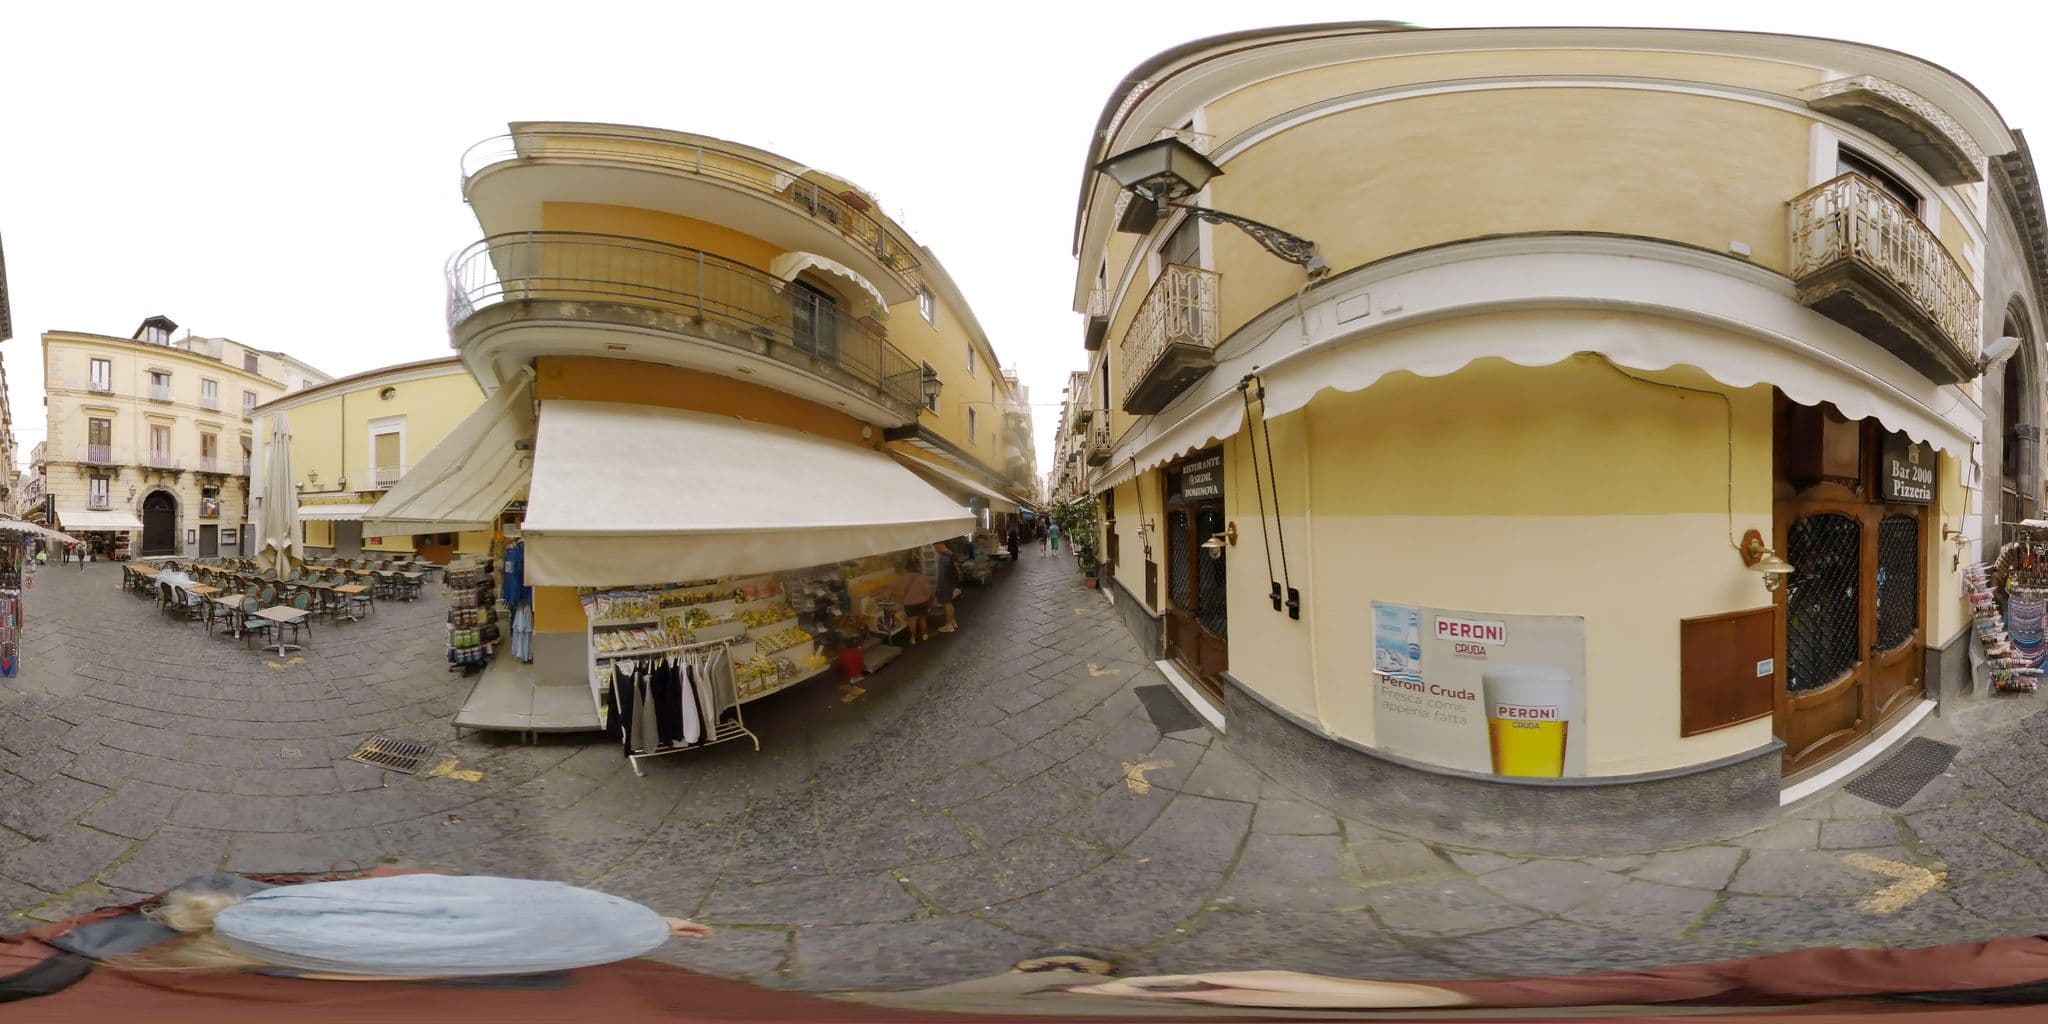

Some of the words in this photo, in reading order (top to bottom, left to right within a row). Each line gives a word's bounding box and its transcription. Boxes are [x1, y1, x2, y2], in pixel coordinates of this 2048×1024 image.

[1183, 456, 1221, 474] RISTORANTE
[1892, 460, 1910, 479] Bar
[1912, 466, 1932, 484] 2000
[1893, 480, 1931, 500] Pizzeria
[1438, 621, 1504, 641] PERONI
[1455, 644, 1486, 656] CRUDA
[1382, 675, 1425, 693] Peroni
[1430, 684, 1476, 701] Cruda
[1382, 687, 1422, 705] Fresca
[1427, 699, 1467, 712] come
[1383, 701, 1430, 719] appena
[1434, 711, 1468, 726] fatta
[1499, 707, 1555, 719] PERONI
